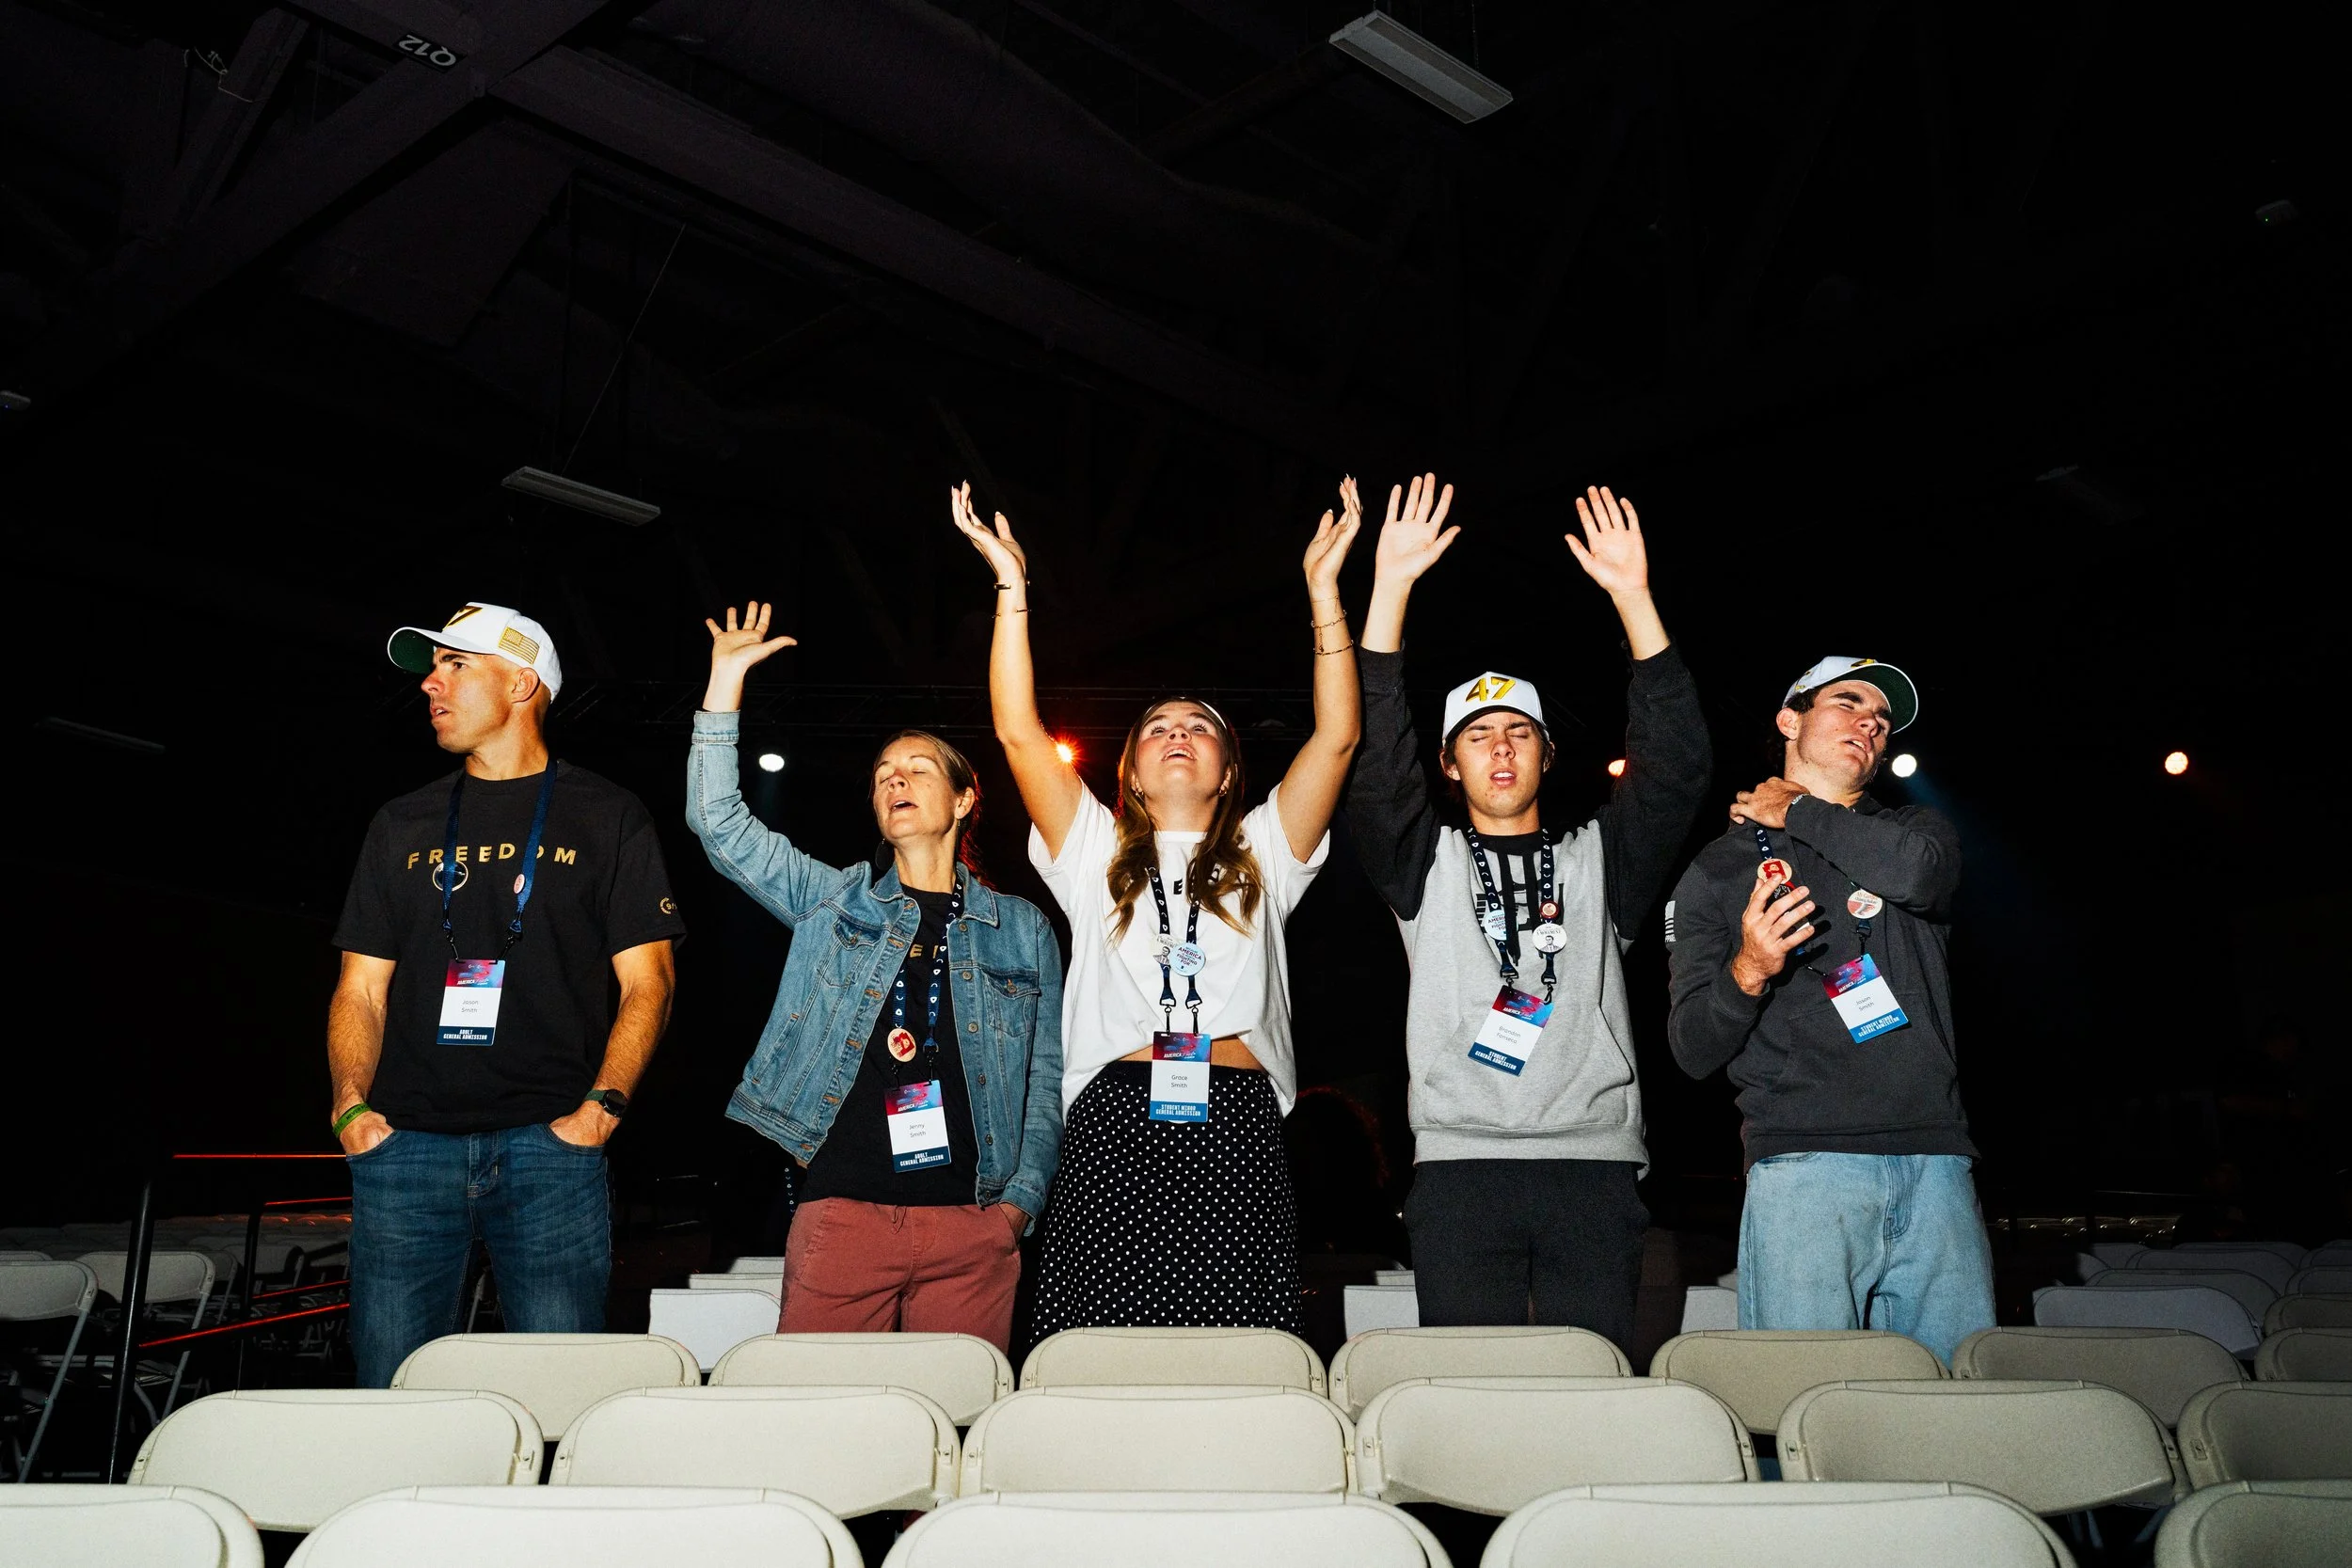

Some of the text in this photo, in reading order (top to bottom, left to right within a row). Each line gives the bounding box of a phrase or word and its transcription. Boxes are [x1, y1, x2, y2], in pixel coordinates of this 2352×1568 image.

[398, 34, 457, 67] Q12
[442, 605, 484, 631] 7
[1466, 676, 1516, 702] 47
[1176, 953, 1198, 965] FIGHTING
[1178, 946, 1201, 960] AMERICA
[1858, 1002, 1874, 1012] Smith
[1496, 1032, 1518, 1044] Fonseca
[1474, 1050, 1518, 1070] GENERAL ADMISSION
[898, 1103, 915, 1112] AMERICA
[899, 1153, 945, 1167] GENERAL ADMISSION
